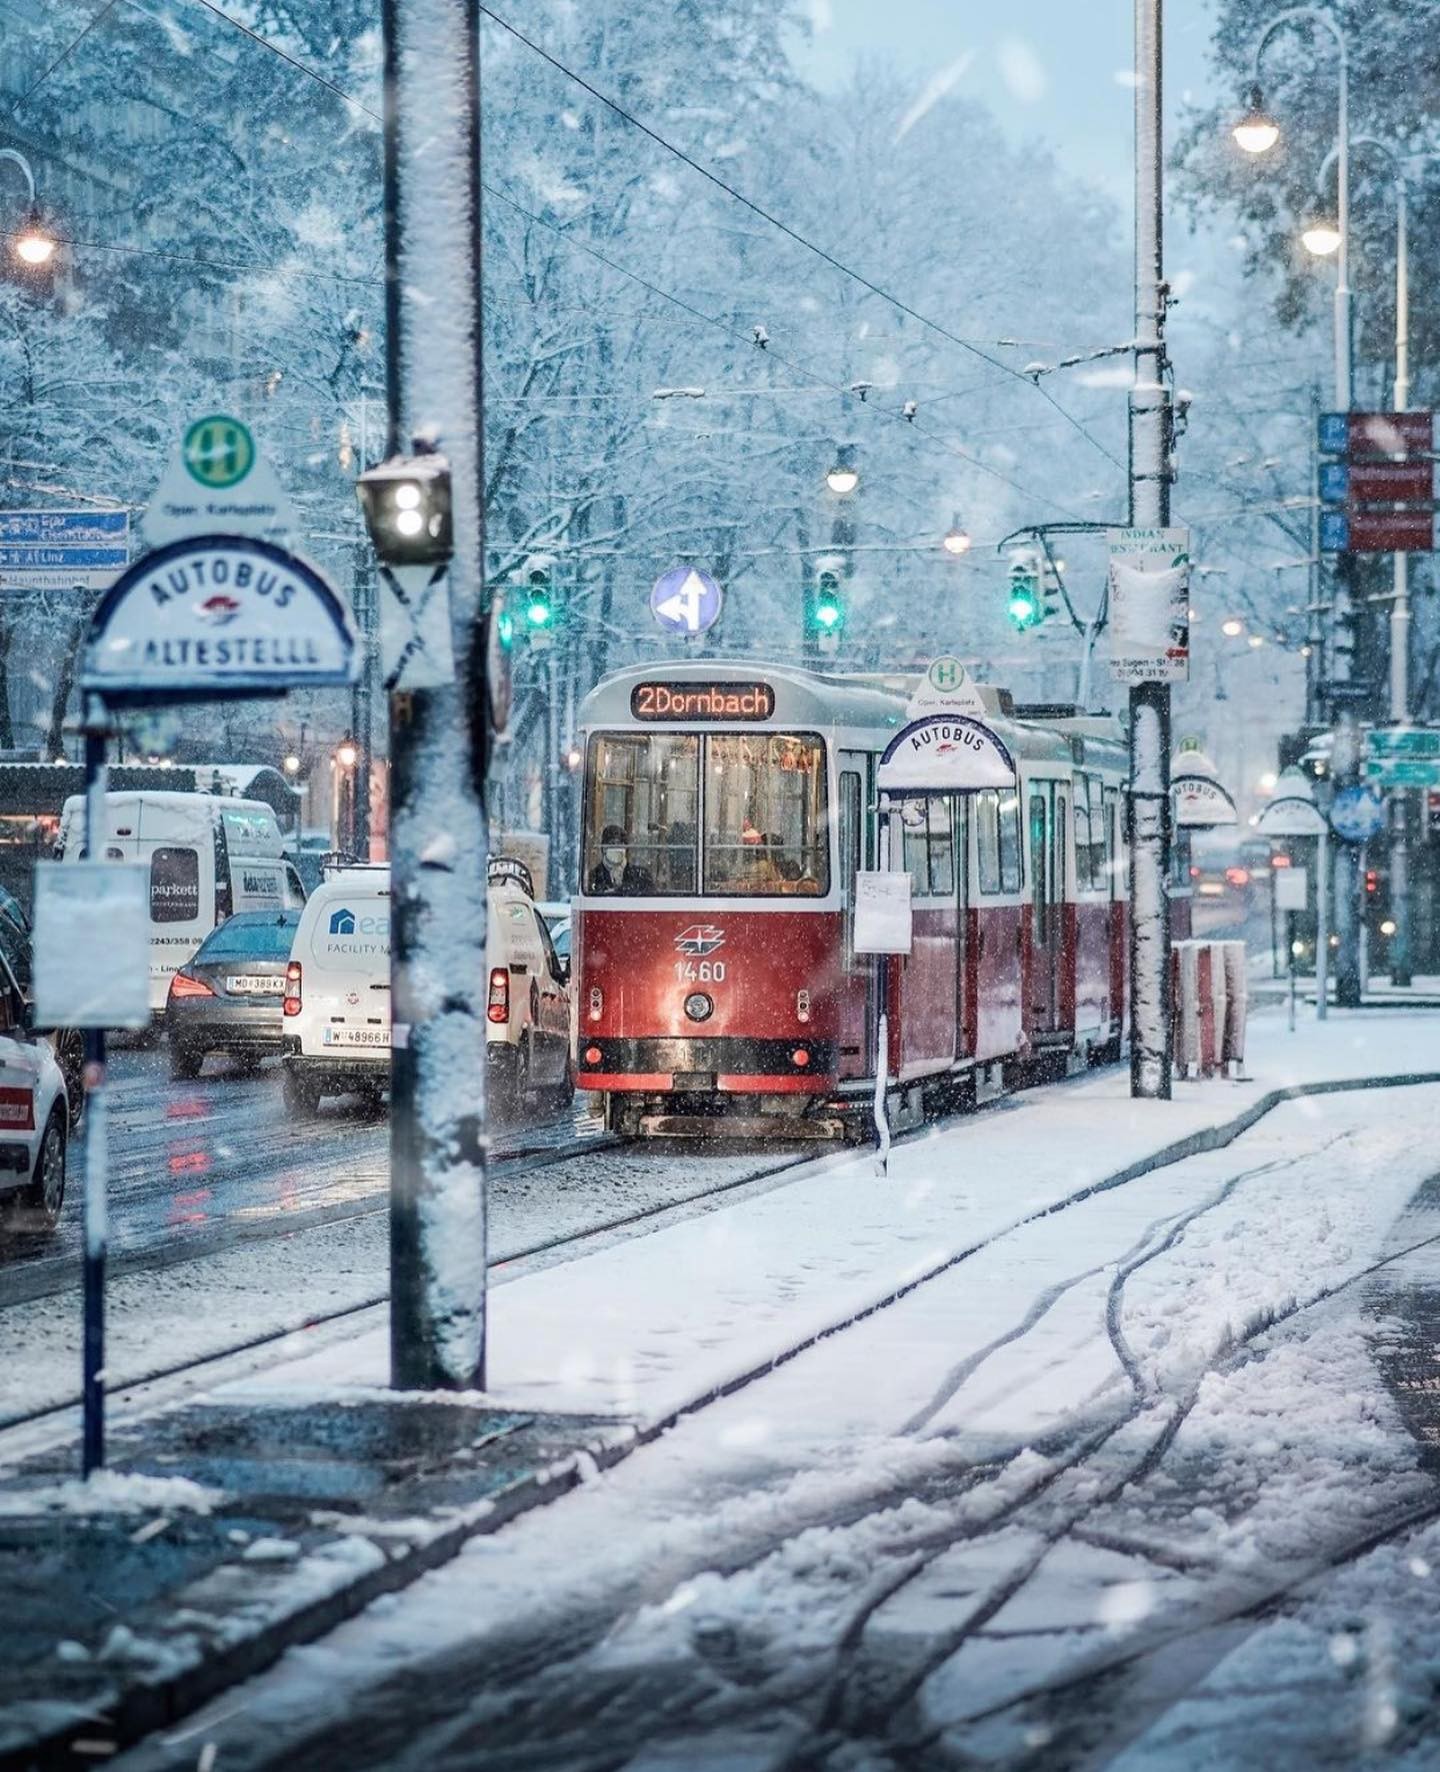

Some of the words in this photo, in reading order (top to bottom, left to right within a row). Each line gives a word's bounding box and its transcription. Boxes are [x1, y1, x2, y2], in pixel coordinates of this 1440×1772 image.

[150, 558, 297, 608] AUTOBUS
[910, 726, 985, 751] AUTOBUS
[1174, 782, 1217, 800] UTOBUS
[151, 883, 198, 900] parkett
[327, 943, 377, 954] FACILITY
[673, 960, 726, 983] 1460
